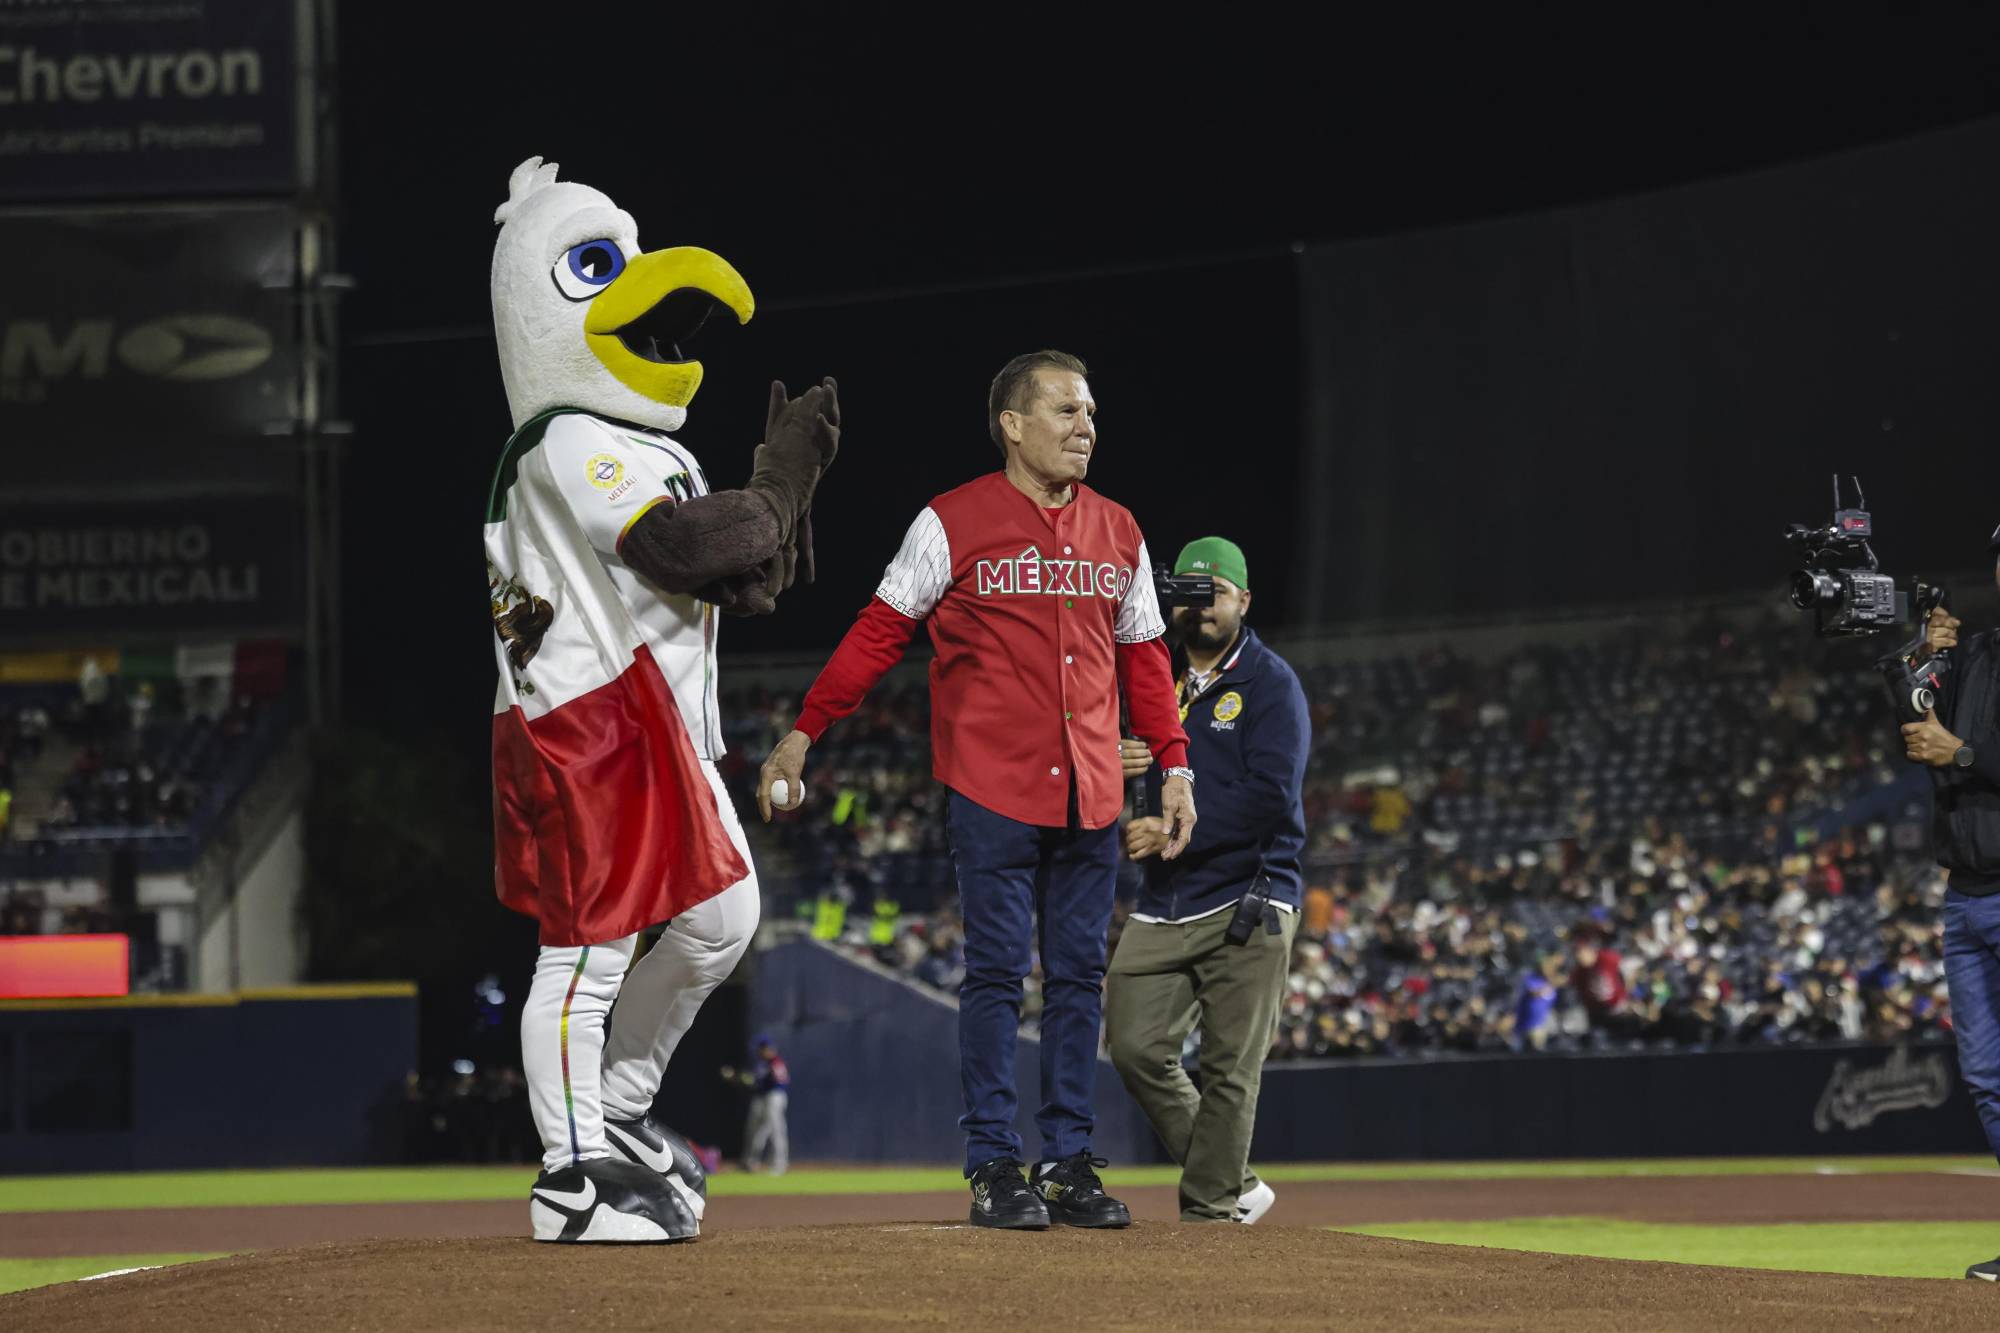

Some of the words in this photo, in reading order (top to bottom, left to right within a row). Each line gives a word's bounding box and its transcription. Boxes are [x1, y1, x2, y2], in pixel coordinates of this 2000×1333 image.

[139, 120, 264, 149] Premium
[36, 563, 259, 608] MEXICALI
[977, 545, 1134, 602] MÉXICO
